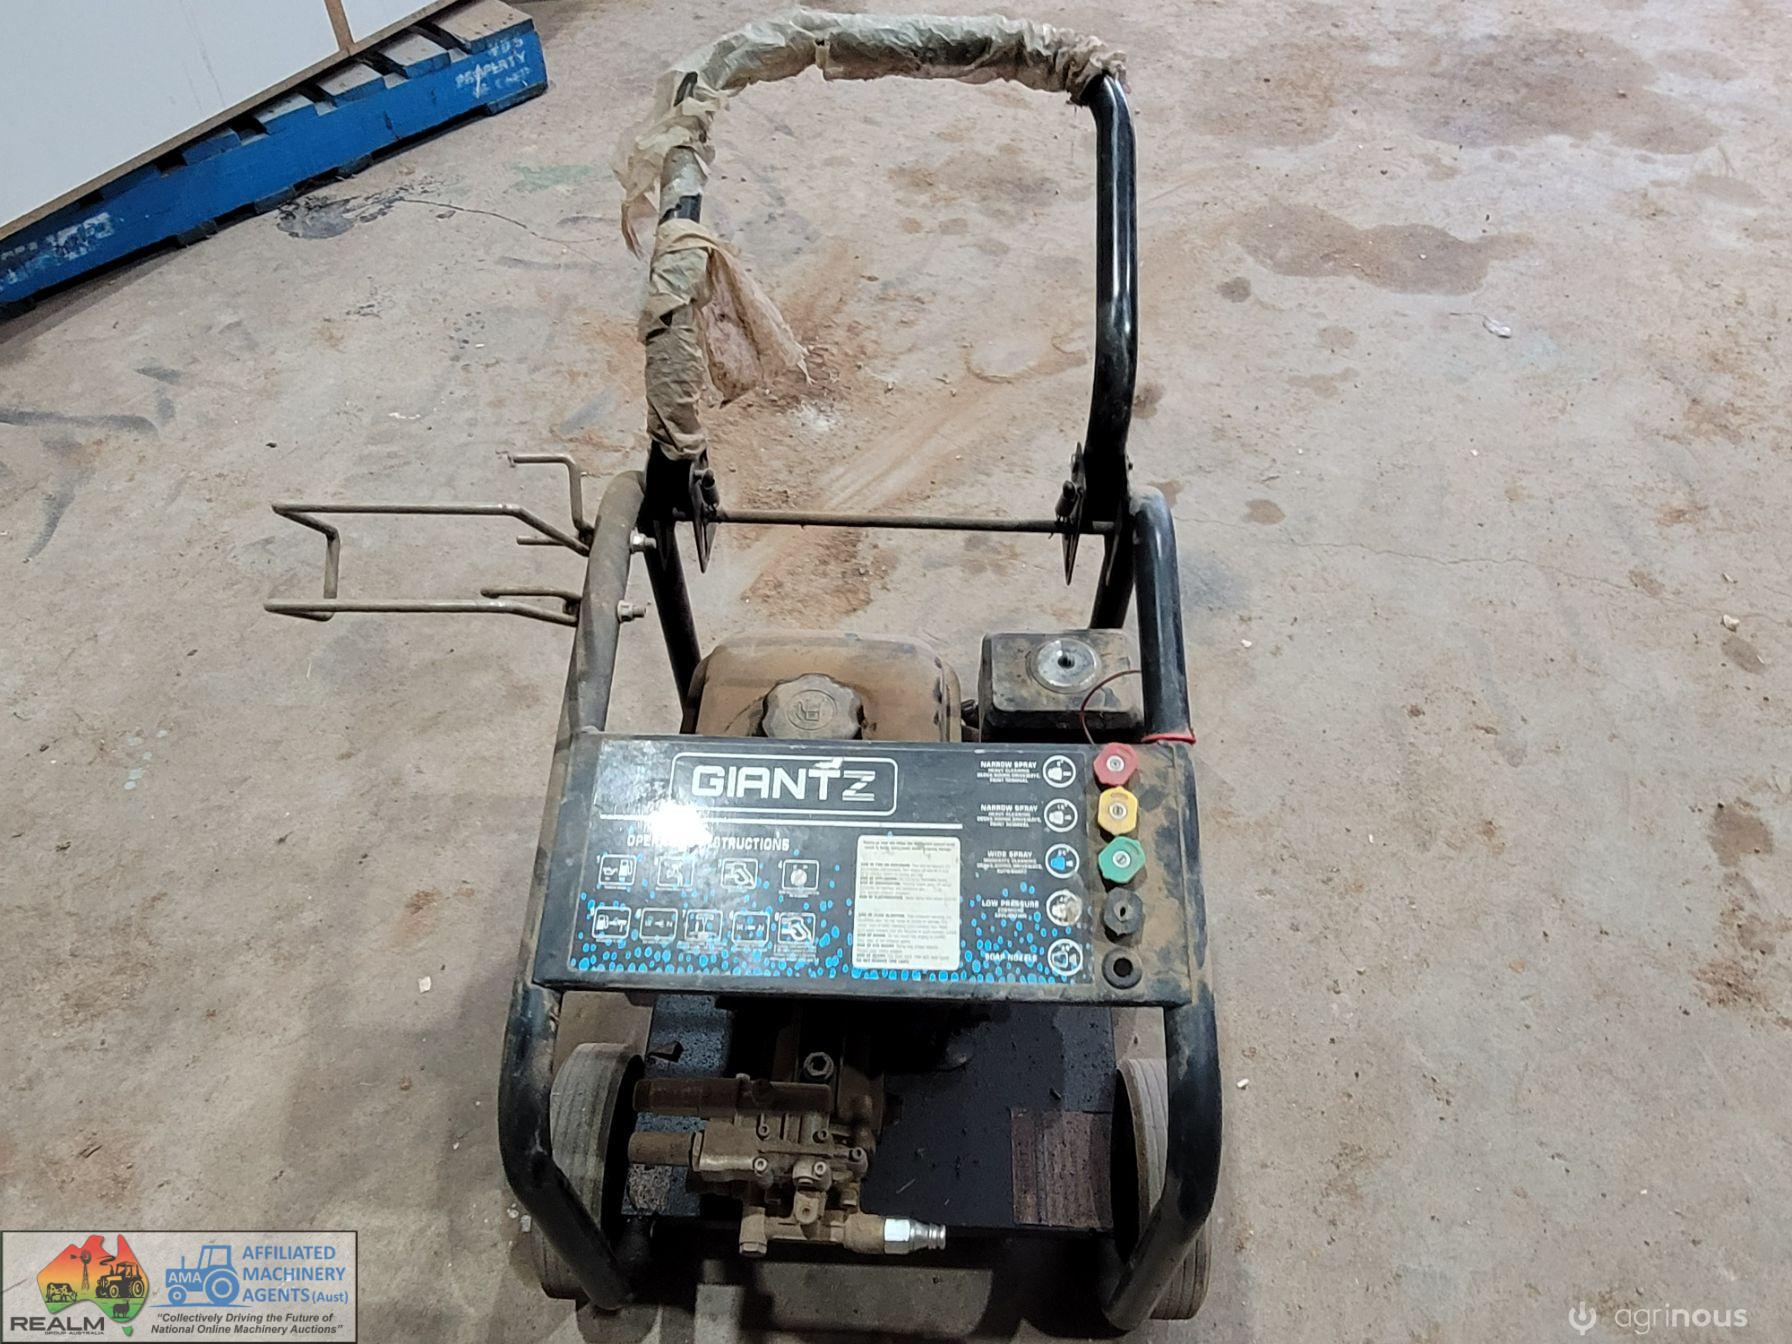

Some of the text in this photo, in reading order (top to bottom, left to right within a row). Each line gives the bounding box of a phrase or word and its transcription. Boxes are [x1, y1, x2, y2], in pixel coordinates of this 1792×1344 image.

[691, 764, 876, 802] GIANTZ
[981, 804, 1038, 812] NARROW SPRAY
[1009, 850, 1032, 858] SPRAY
[981, 899, 1039, 909] LOW PRESSURE
